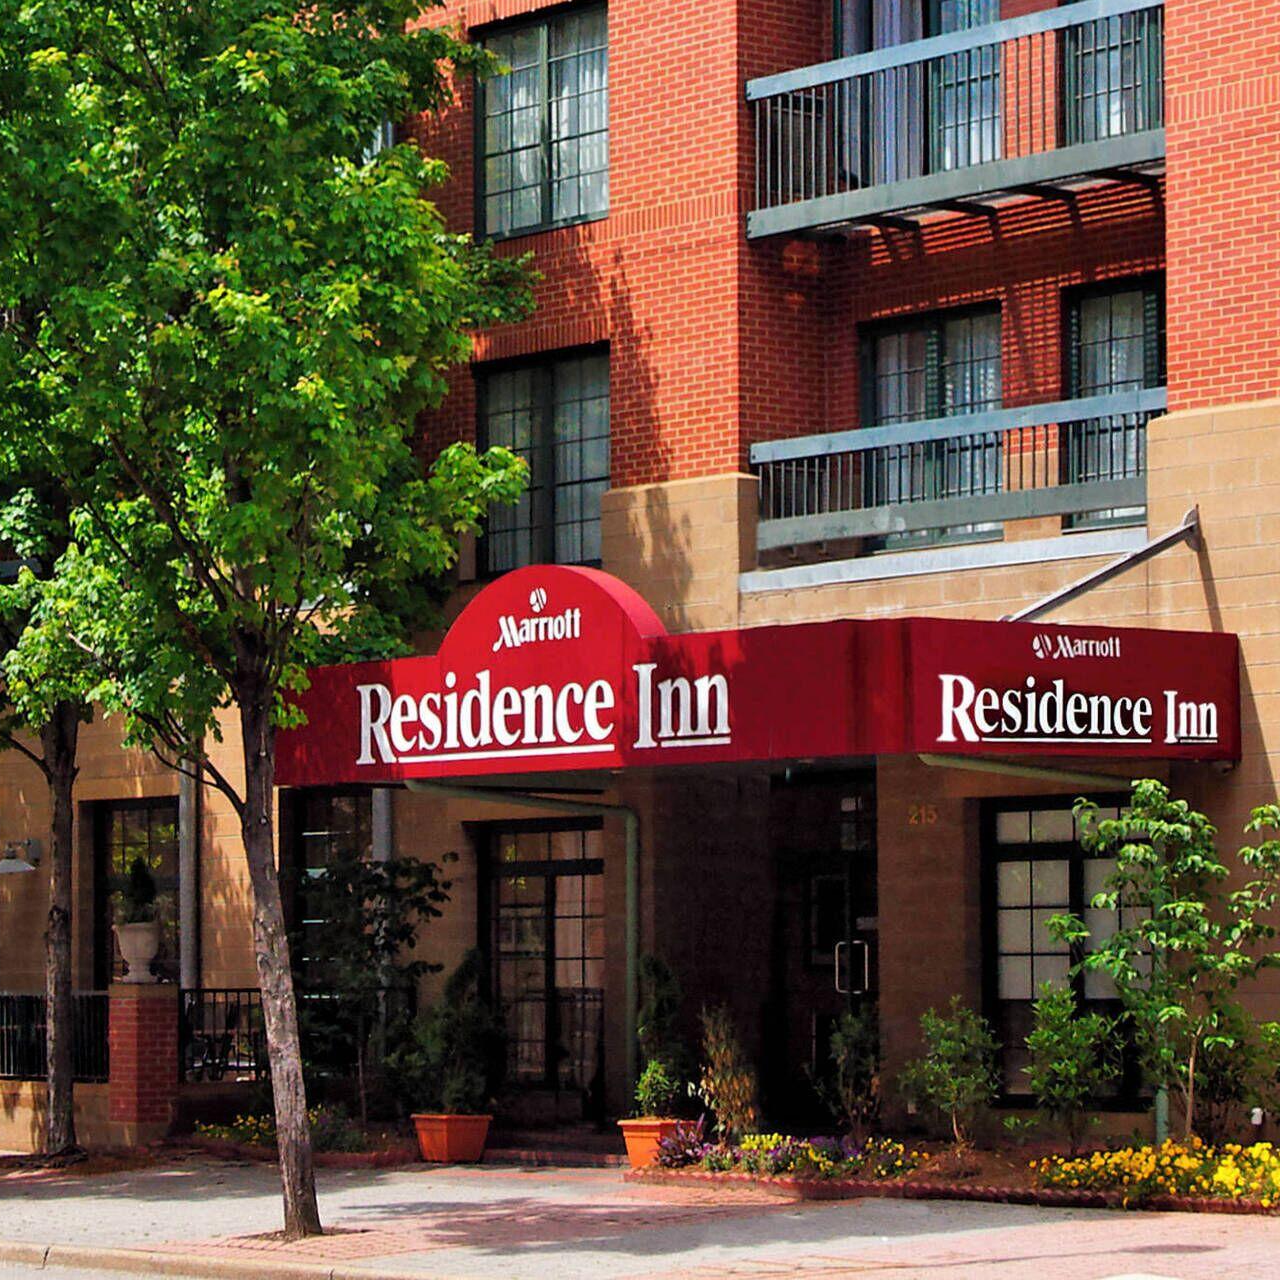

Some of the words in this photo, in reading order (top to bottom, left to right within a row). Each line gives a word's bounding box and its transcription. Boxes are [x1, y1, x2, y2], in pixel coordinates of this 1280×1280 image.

[492, 607, 582, 653] Marriott
[1052, 634, 1121, 660] Marriott
[356, 669, 615, 765] Residence
[631, 663, 732, 749] Inn
[936, 673, 1152, 743] Residence
[1163, 690, 1218, 744] Inn
[907, 803, 938, 825] 215
